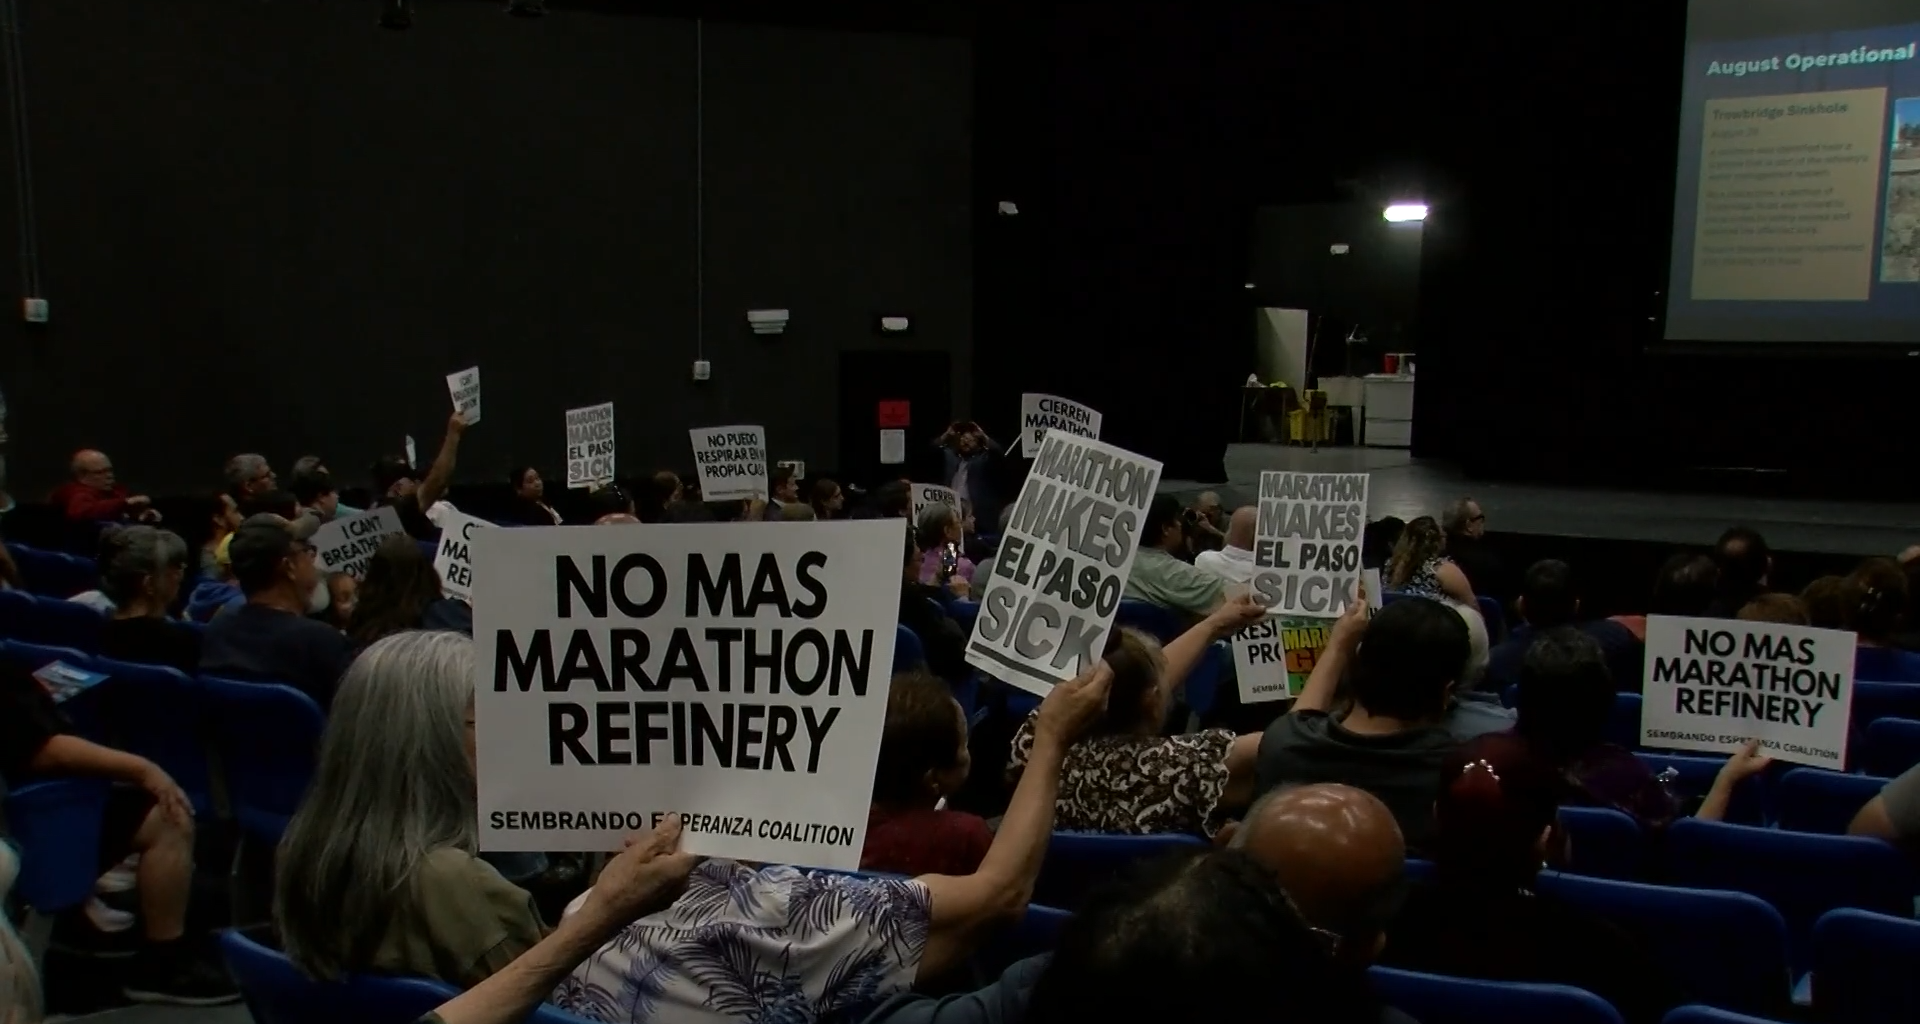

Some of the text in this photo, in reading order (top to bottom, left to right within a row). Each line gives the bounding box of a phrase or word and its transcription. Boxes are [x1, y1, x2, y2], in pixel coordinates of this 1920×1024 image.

[1706, 42, 1916, 76] August Operational
[1039, 399, 1090, 425] CIERREN
[568, 421, 612, 445] MAKES
[569, 440, 613, 459] EL PASO
[707, 433, 757, 447] NO PUEDO
[1034, 430, 1047, 443] R
[569, 456, 612, 480] SICK
[697, 448, 747, 463] RESPIRAR
[705, 464, 746, 477] PROPIA
[1034, 437, 1154, 509] MARATHON
[1261, 473, 1364, 501] MARATHON
[341, 525, 350, 539] I
[1011, 479, 1137, 568] MAKES
[1258, 501, 1361, 541] MAKES
[1256, 540, 1359, 572] EL PASO
[556, 551, 828, 619] NO MAS
[995, 535, 1120, 618] EL PASO
[1253, 572, 1356, 612] SICK
[979, 585, 1104, 676] SICK
[1684, 629, 1815, 665] NO MAS
[493, 627, 874, 696] MARATHON
[1652, 657, 1841, 700] MARATHON
[1676, 687, 1824, 728] REFINERY
[548, 701, 841, 773] REFINERY
[1646, 729, 1715, 743] SEMBRANDO
[1783, 743, 1839, 760] COALITION
[490, 811, 854, 846] SEMBRANDO EPERANZA COALITION
